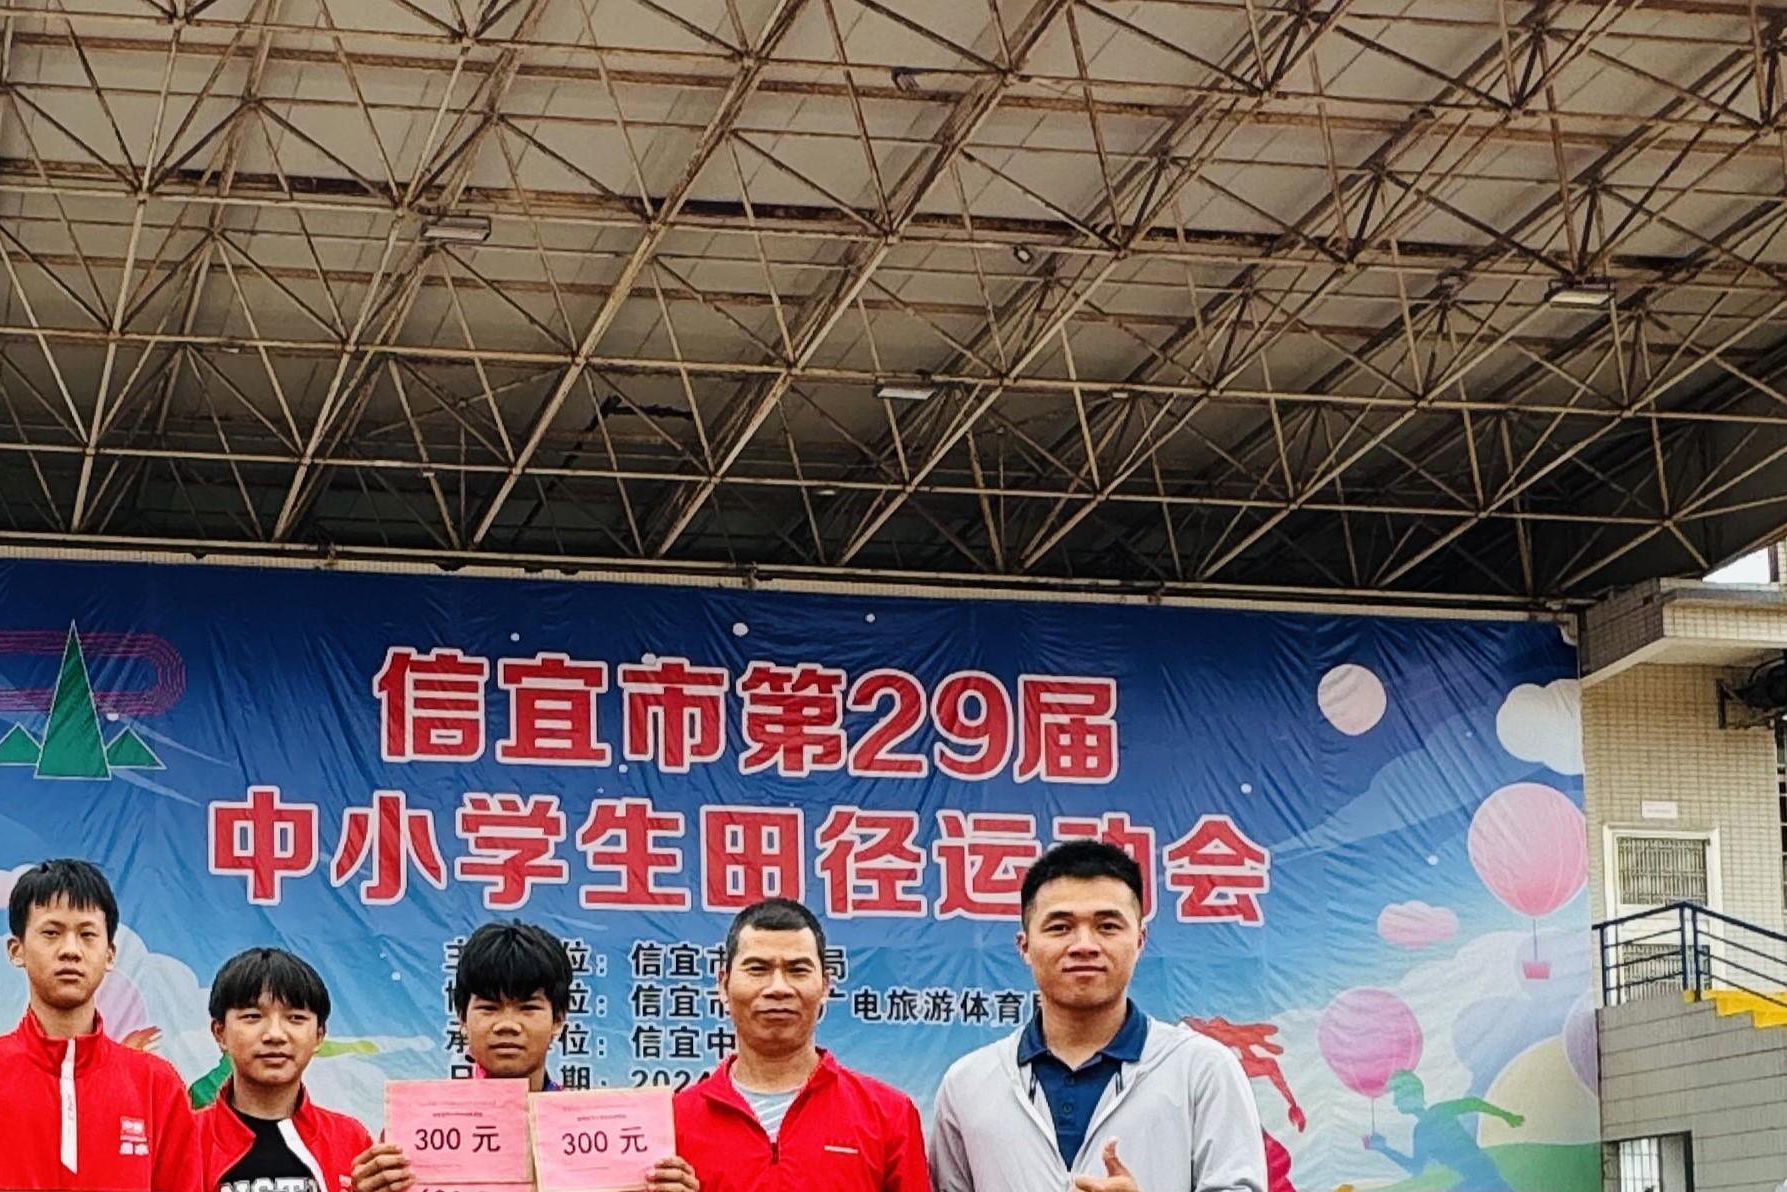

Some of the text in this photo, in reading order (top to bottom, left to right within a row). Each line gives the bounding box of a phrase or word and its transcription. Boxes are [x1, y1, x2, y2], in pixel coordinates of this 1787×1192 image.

[376, 647, 1118, 784] 信宜市第29届
[631, 943, 846, 980] 信宜市局
[415, 1126, 501, 1152] 300 元
[561, 1127, 649, 1156] 300 元
